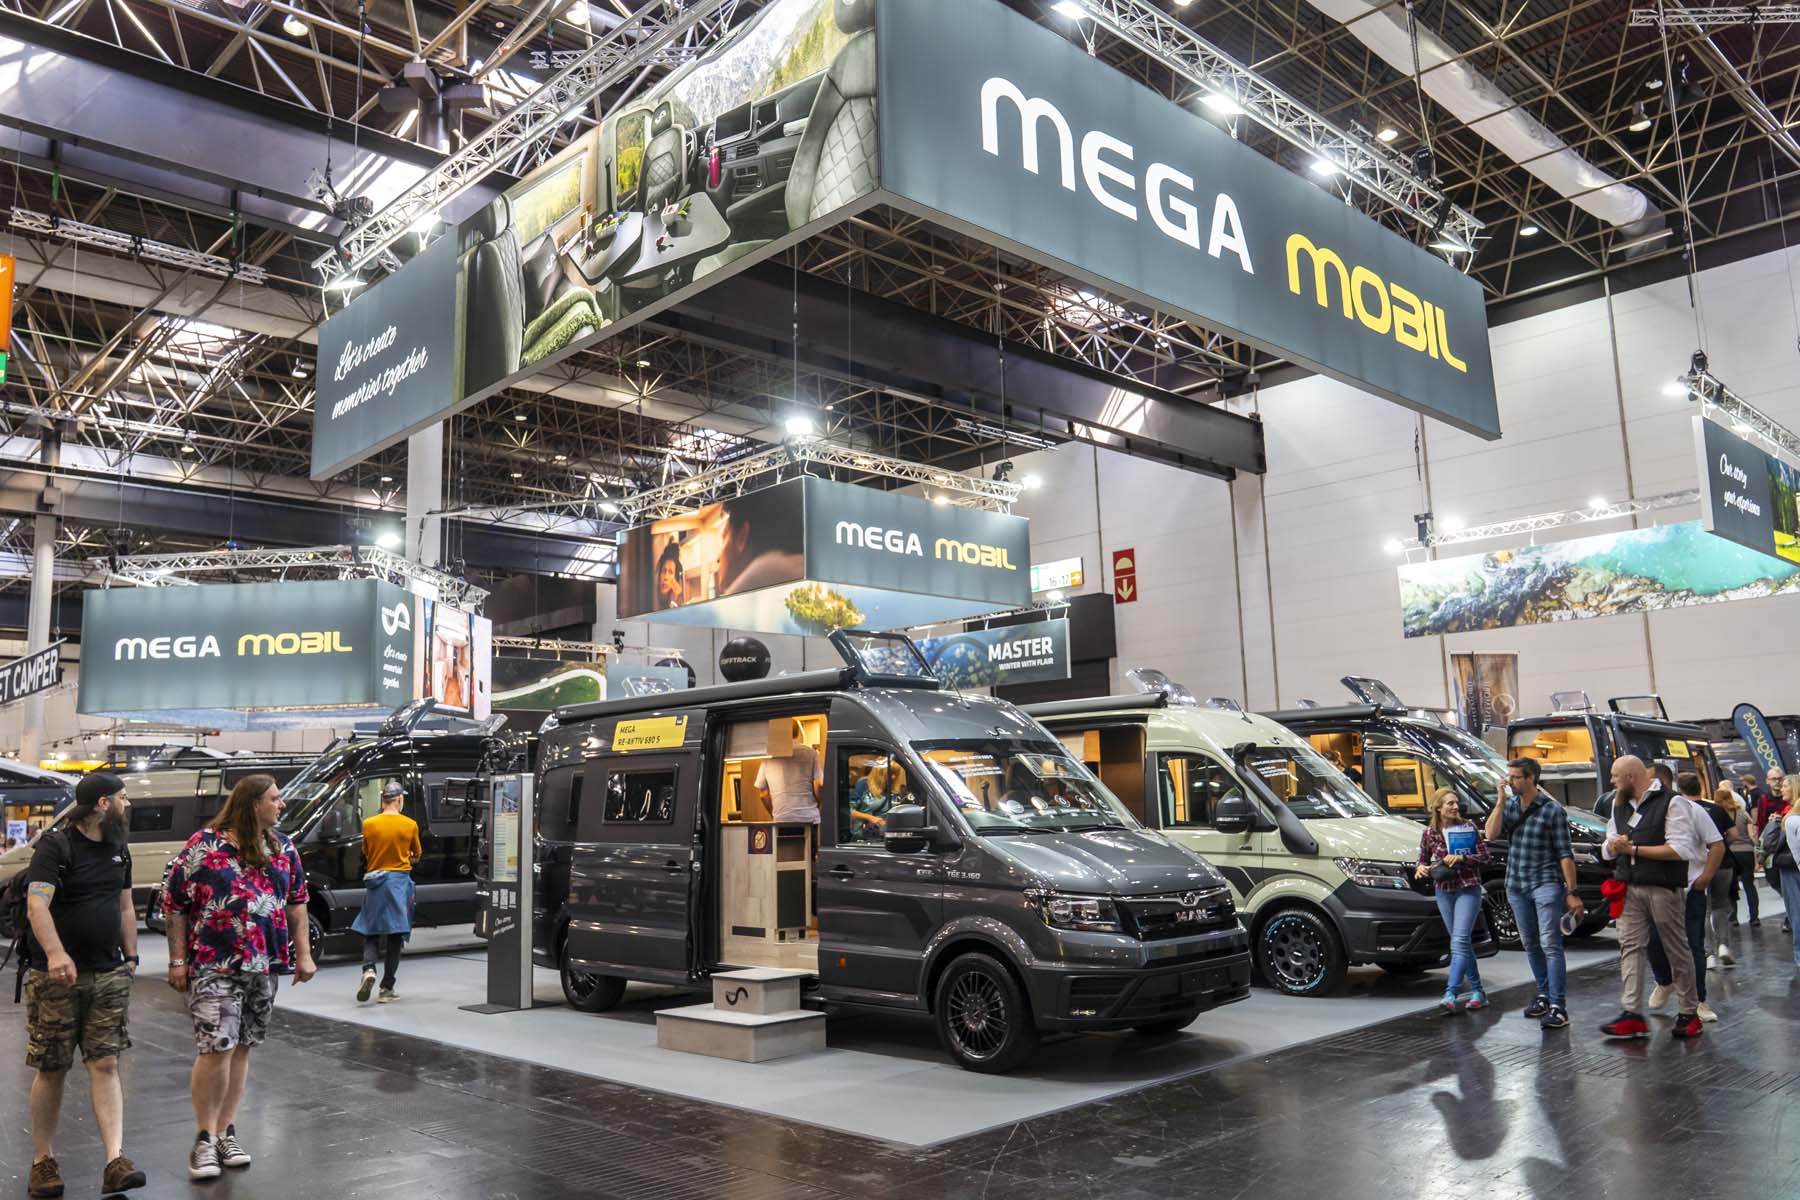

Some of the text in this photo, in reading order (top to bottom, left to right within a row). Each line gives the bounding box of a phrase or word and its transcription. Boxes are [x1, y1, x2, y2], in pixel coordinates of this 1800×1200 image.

[980, 77, 1467, 374] MEGA MOBIL
[333, 325, 397, 382] Let's create
[331, 346, 429, 420] memories together
[835, 520, 1017, 570] MEGA MOBIL
[114, 631, 353, 660] MEGA MOBIL
[988, 636, 1054, 662] MASTER
[998, 657, 1054, 671] WINTER WITH FLAIR
[13, 649, 58, 697] CAMPER
[620, 725, 636, 734] MEGA
